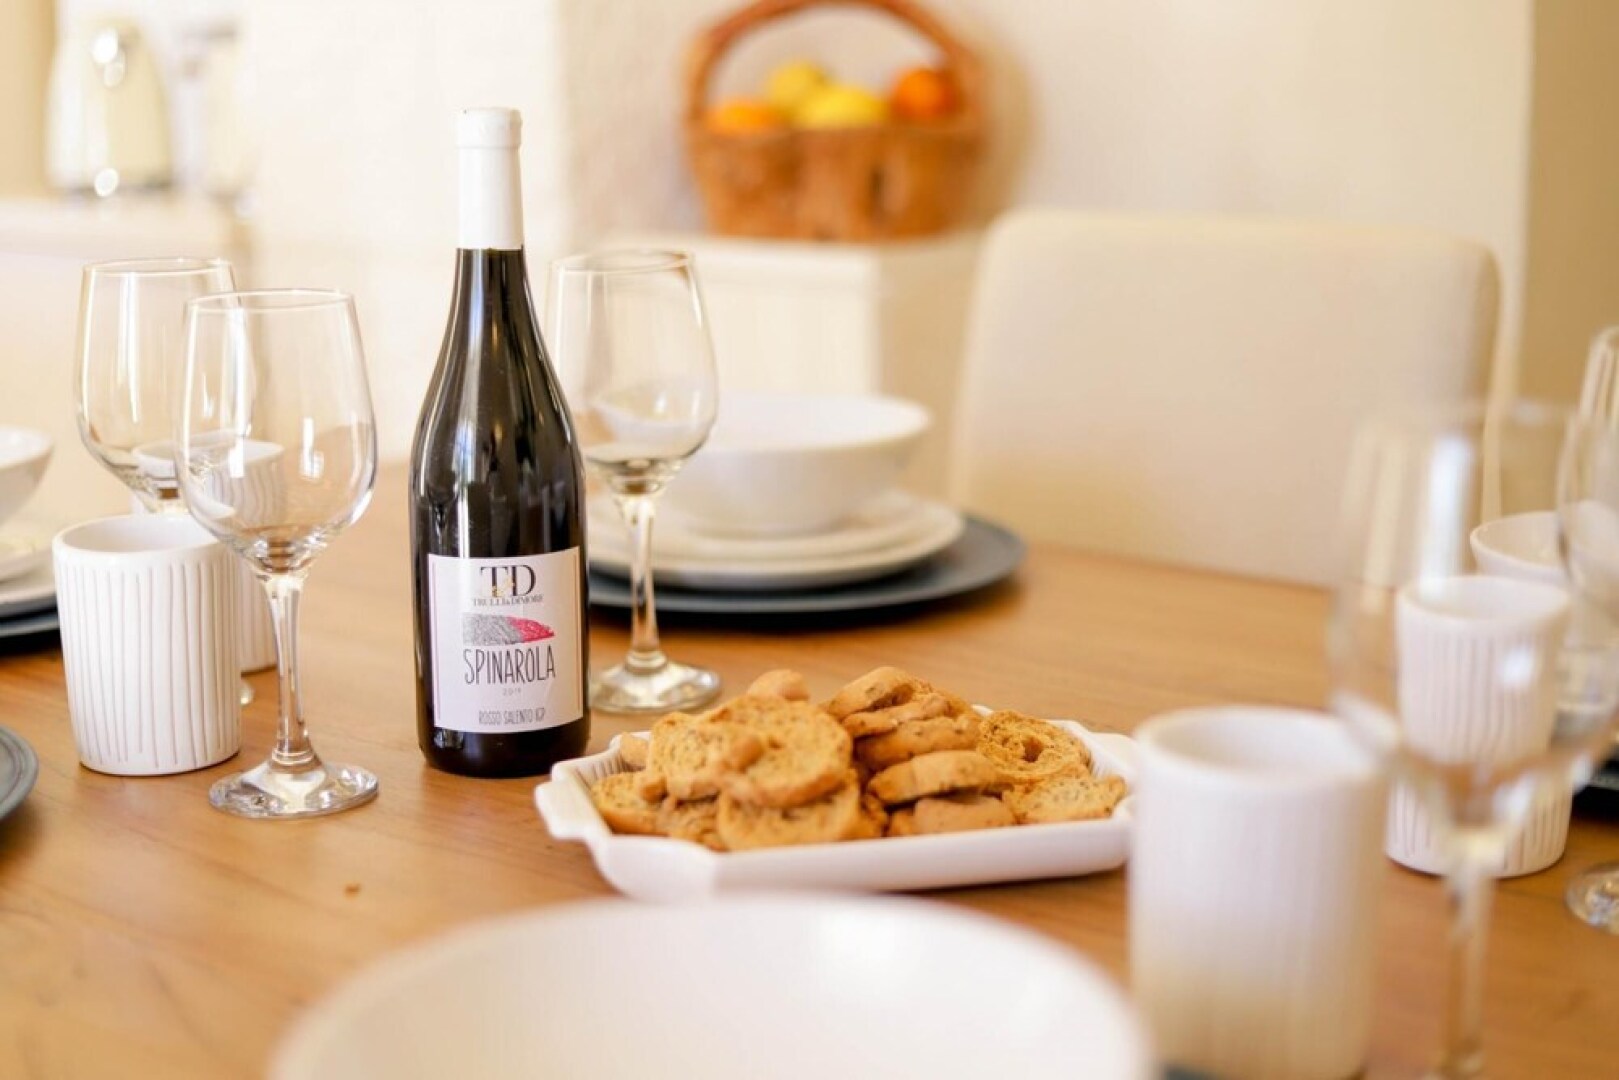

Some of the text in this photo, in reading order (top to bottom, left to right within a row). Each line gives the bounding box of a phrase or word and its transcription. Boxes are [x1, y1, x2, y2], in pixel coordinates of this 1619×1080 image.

[463, 645, 556, 685] SPINAROLA
[478, 710, 501, 725] ROSSO
[503, 708, 533, 725] SALENTO
